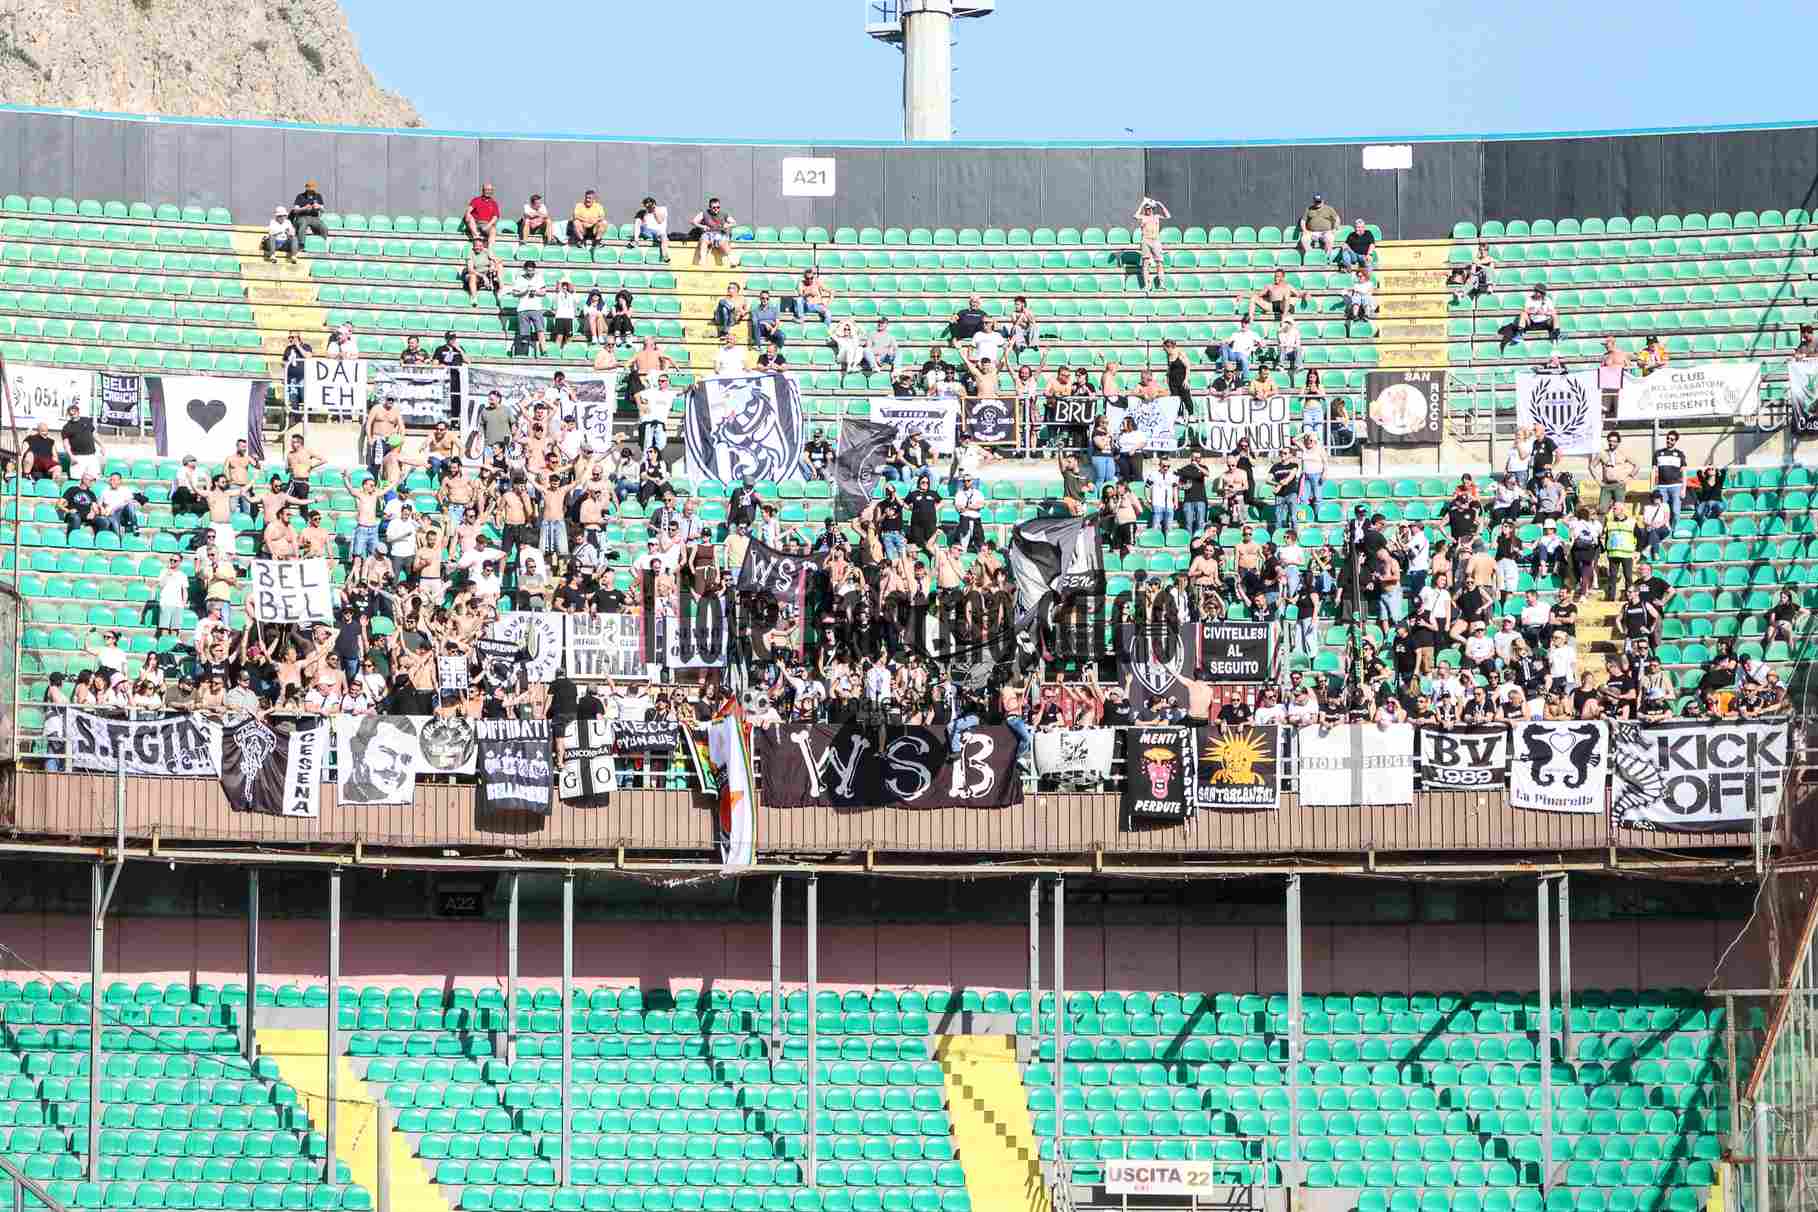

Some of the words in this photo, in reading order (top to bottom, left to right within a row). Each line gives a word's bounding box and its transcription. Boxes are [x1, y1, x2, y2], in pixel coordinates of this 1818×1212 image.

[792, 169, 826, 185] A21
[316, 361, 359, 384] DAI
[1671, 372, 1705, 383] CLUB
[322, 386, 354, 406] EH
[1055, 400, 1096, 423] BRU
[1206, 396, 1286, 424] LUPO
[256, 562, 319, 588] BEL
[259, 590, 325, 620] BEL
[1203, 627, 1267, 640] CIVITELLESI
[1226, 643, 1244, 658] AL
[1210, 660, 1259, 675] SEGUITO
[1139, 732, 1177, 745] MENTI
[1425, 733, 1504, 768] BV
[1657, 731, 1785, 772] KICK
[291, 731, 316, 814] CESENA
[1434, 767, 1494, 784] 1989
[1663, 770, 1782, 816] OFF
[1134, 799, 1182, 814] PERDUTE
[1108, 1166, 1183, 1184] USCITA
[1186, 1170, 1210, 1187] 22
